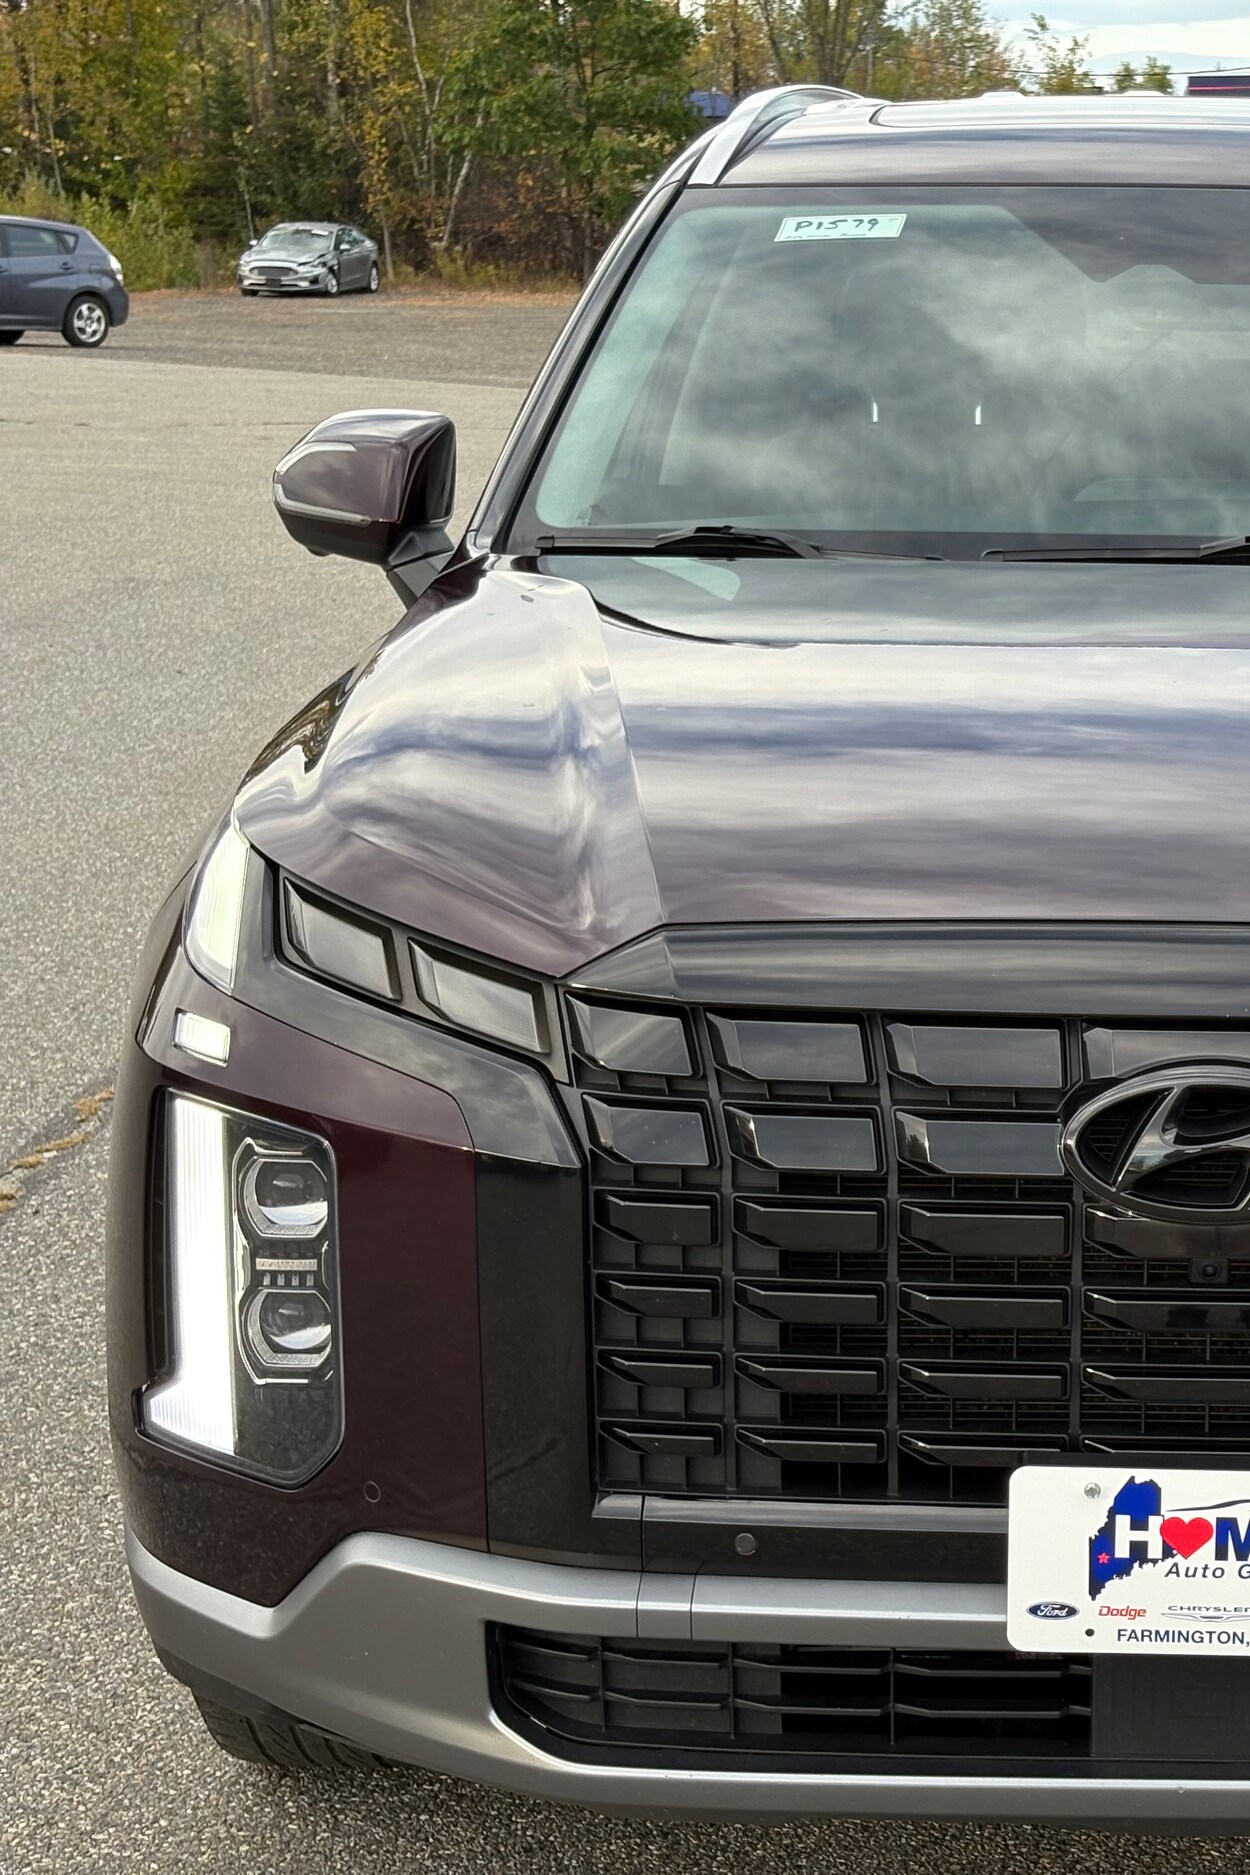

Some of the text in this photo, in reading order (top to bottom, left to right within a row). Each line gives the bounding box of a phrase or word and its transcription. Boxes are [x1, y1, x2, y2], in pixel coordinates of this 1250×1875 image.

[1164, 1562, 1225, 1579] Auto
[1036, 1603, 1068, 1617] Ford
[1098, 1605, 1147, 1620] Dodge
[1116, 1628, 1250, 1647] FARMINGTON,
